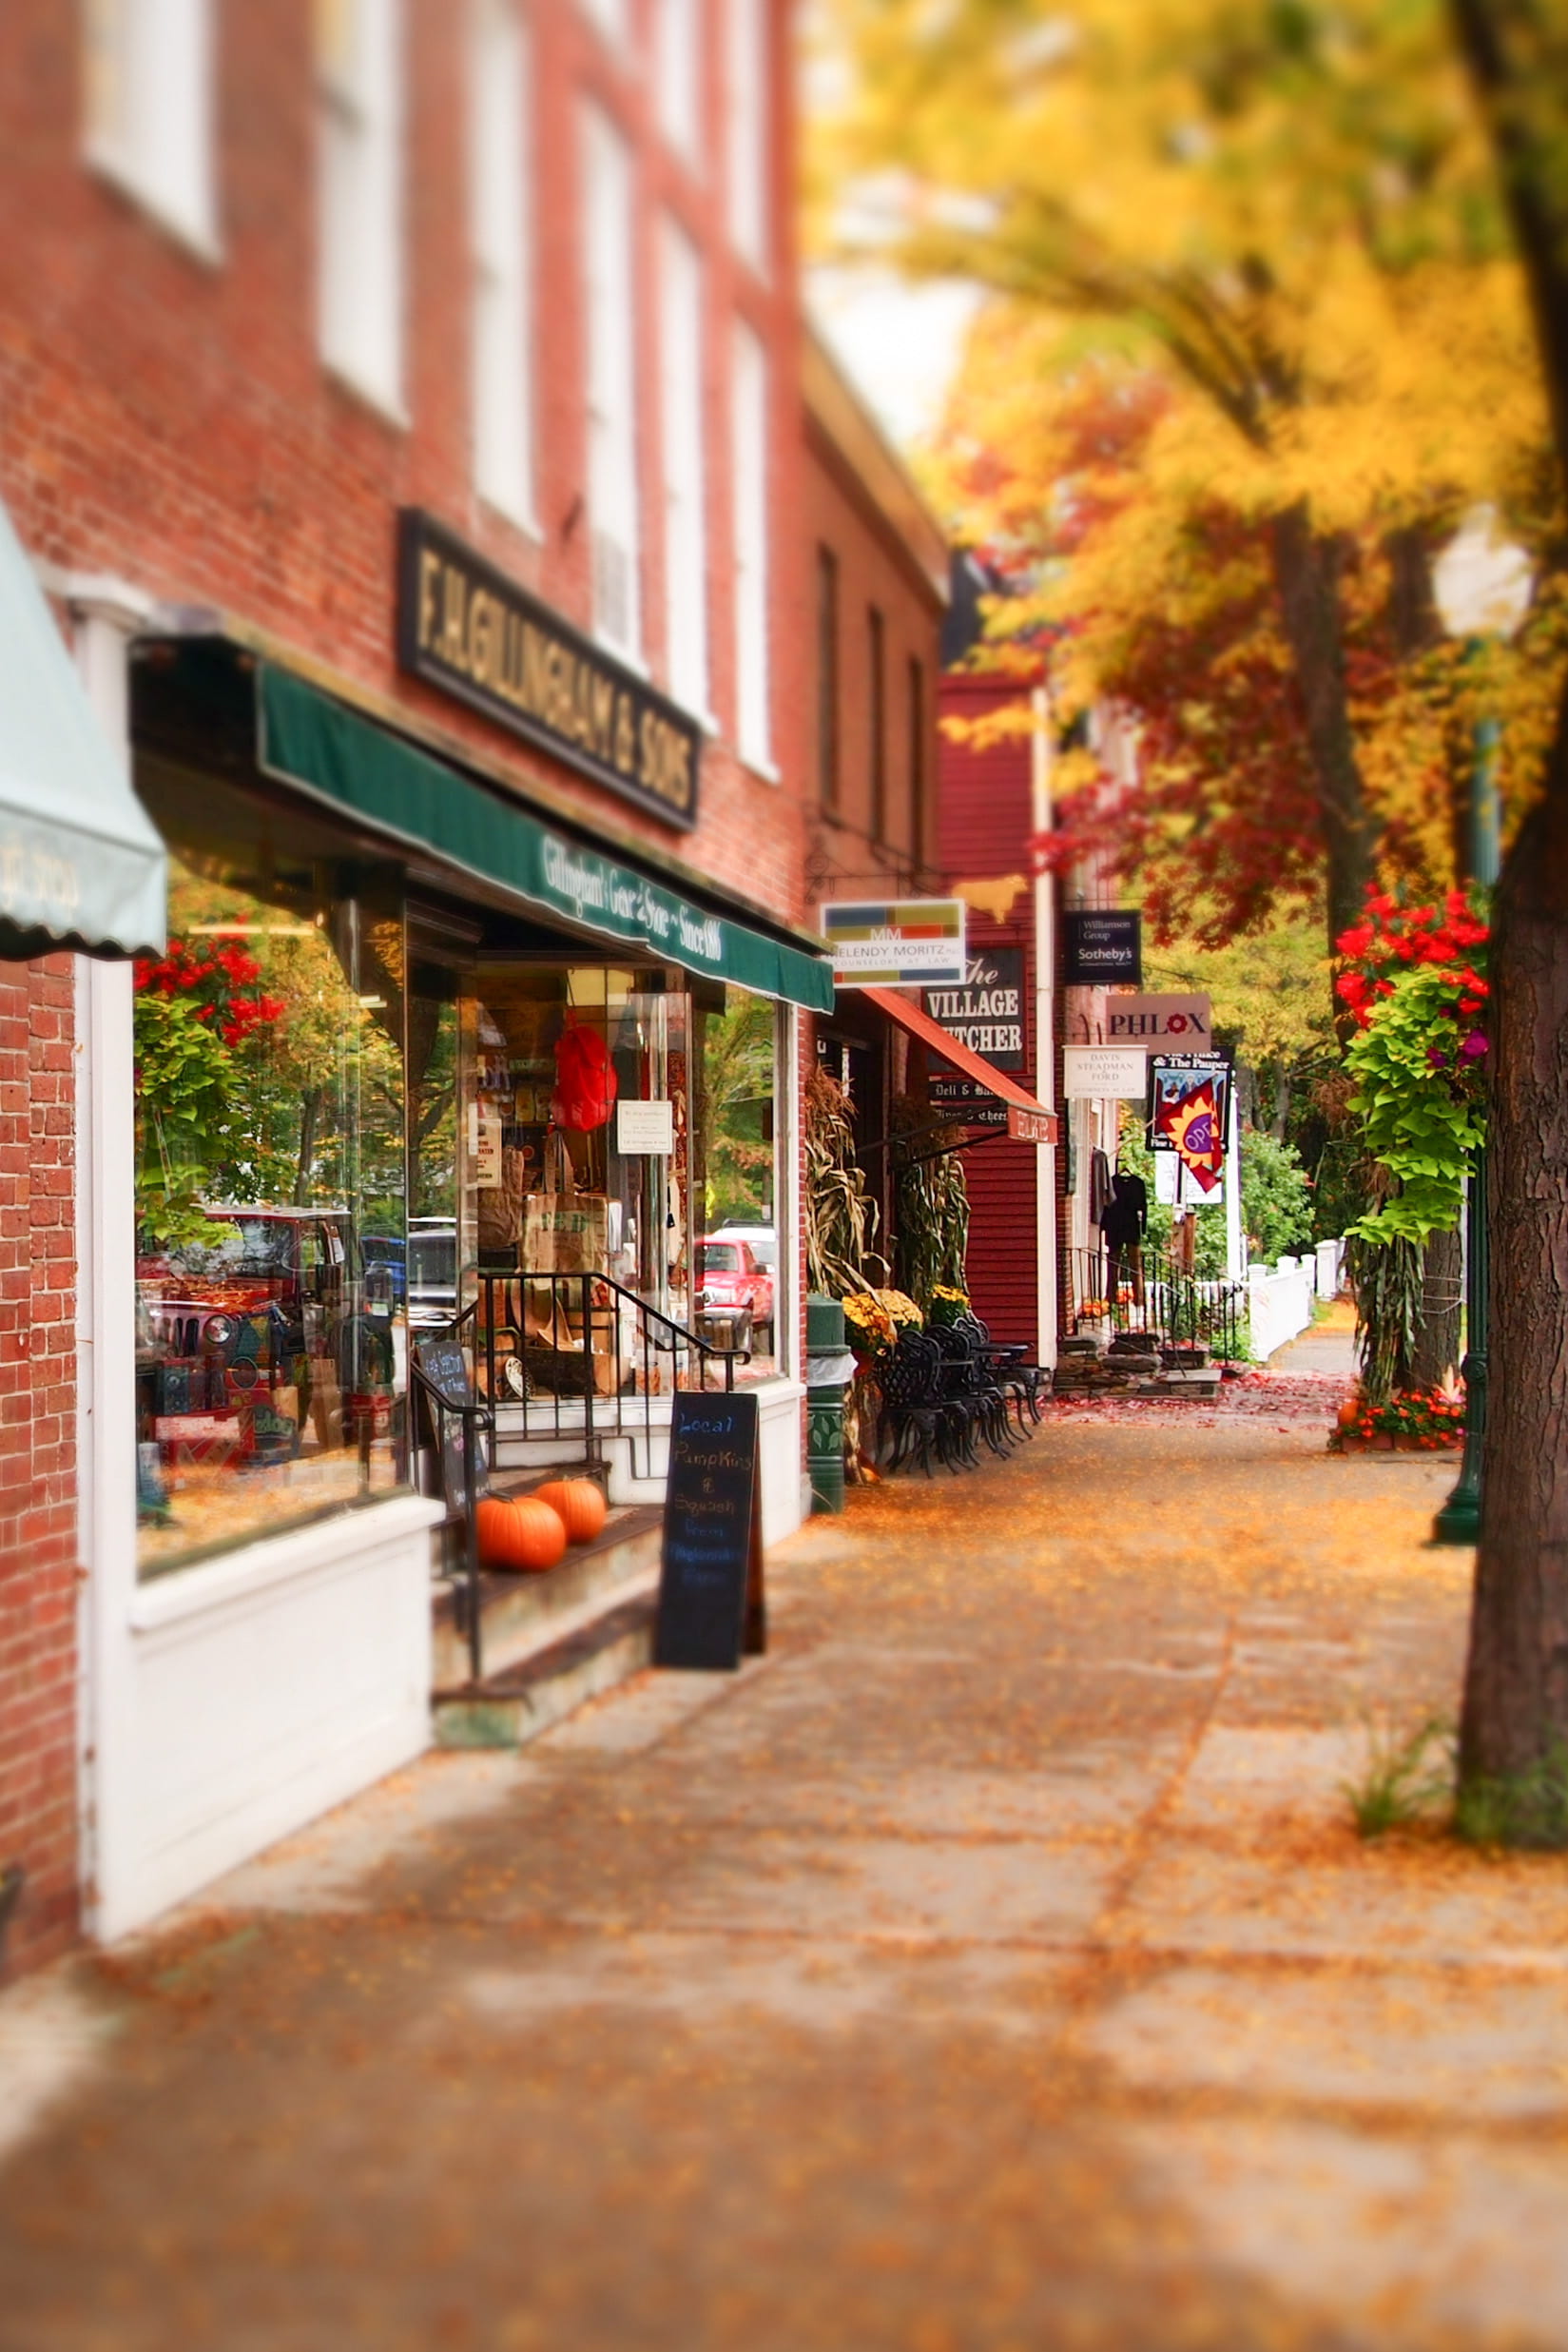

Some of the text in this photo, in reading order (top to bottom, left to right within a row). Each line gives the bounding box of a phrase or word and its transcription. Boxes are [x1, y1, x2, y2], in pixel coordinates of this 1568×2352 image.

[1083, 920, 1132, 929] Williamson
[870, 928, 902, 941] MM
[1083, 930, 1111, 942] Group
[894, 944, 945, 957] MORITZ
[1078, 946, 1132, 962] Sotheby's
[965, 958, 998, 985] The
[927, 989, 1019, 1019] VILLAGE
[1110, 1013, 1206, 1036] PHLOX
[943, 1024, 1023, 1053] TCHER
[1076, 1062, 1133, 1071] STEADMAN
[1152, 1056, 1167, 1067] &
[1169, 1057, 1191, 1068] The
[1192, 1057, 1230, 1071] Pauper
[1091, 1072, 1119, 1081] FORD
[935, 1084, 957, 1096] Deli
[1185, 1122, 1211, 1150] OPE
[679, 1413, 733, 1434] Local
